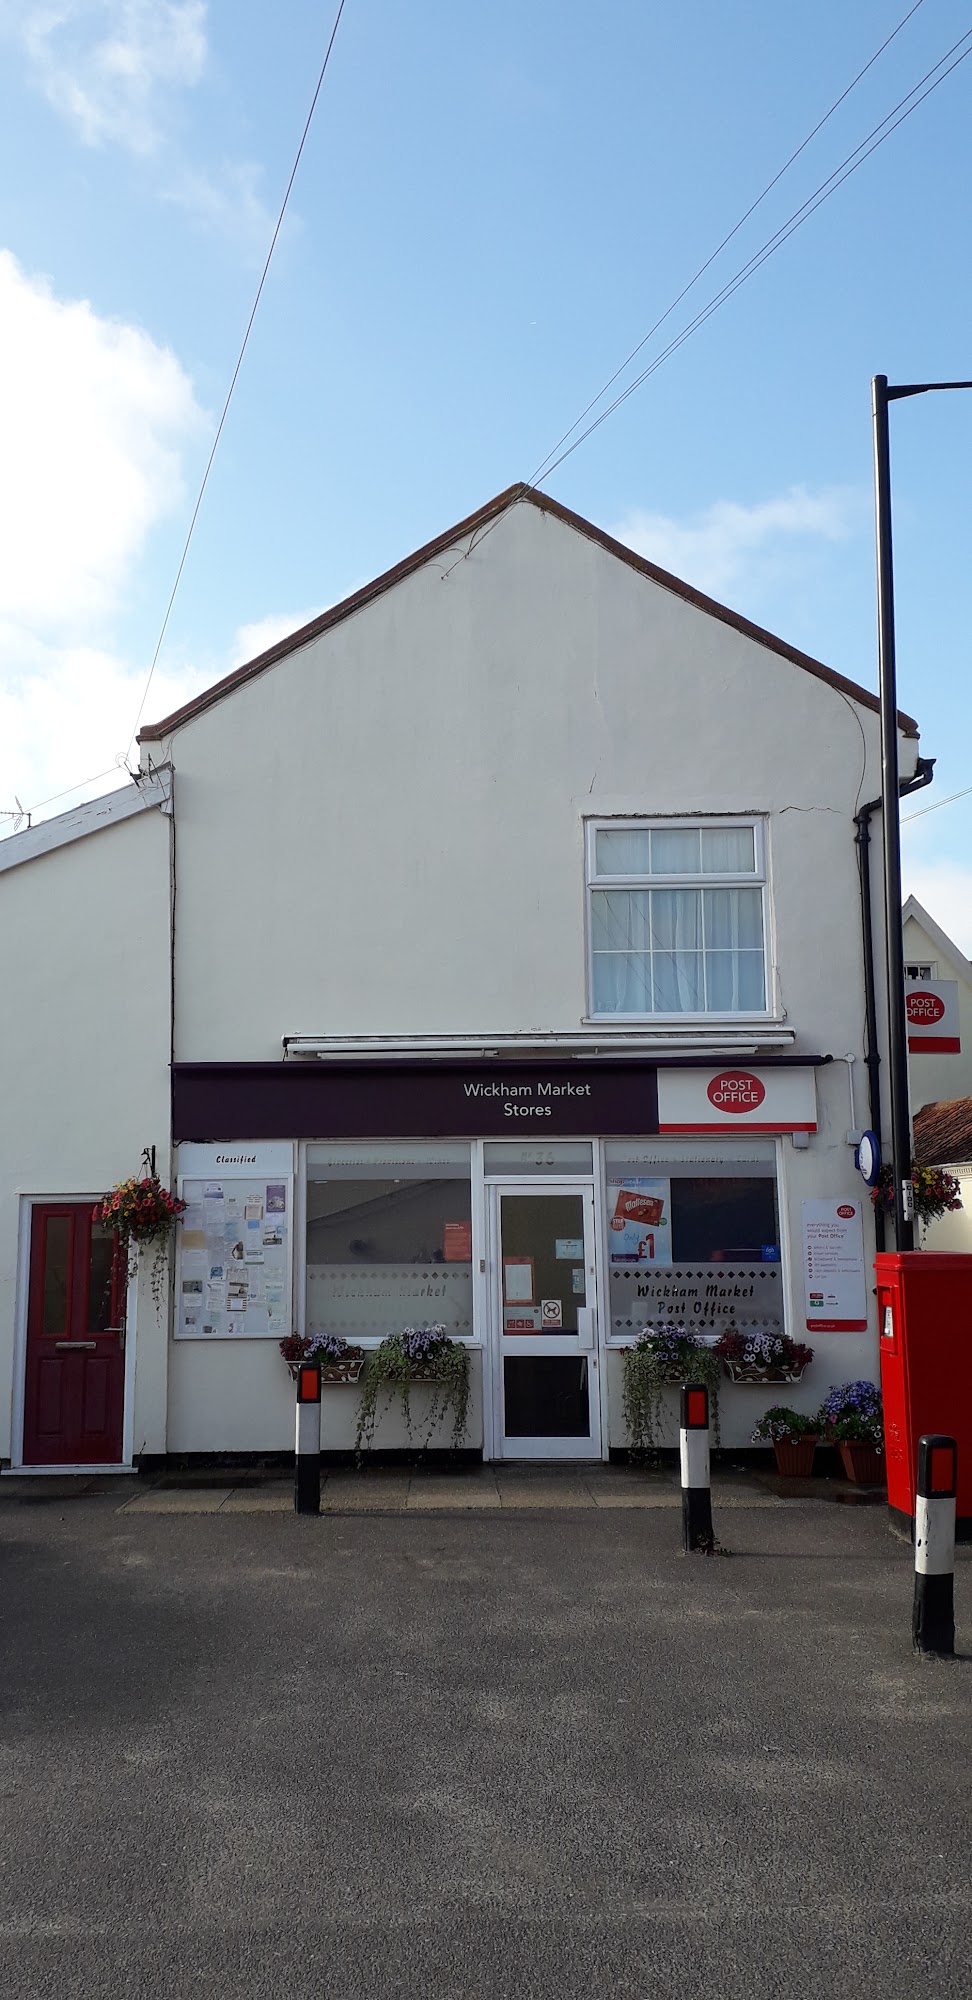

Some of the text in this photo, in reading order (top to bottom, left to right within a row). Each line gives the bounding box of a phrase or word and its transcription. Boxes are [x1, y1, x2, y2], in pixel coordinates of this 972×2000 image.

[910, 998, 936, 1008] POST
[906, 1008, 940, 1017] OFFICE
[463, 1081, 592, 1097] Wickham Market
[720, 1079, 754, 1091] POST
[713, 1091, 759, 1103] OFFICE
[503, 1102, 552, 1117] Stores
[215, 1155, 257, 1165] Classified
[535, 1151, 555, 1166] 36
[637, 1232, 655, 1259] £1
[637, 1284, 755, 1297] Wickham Market
[657, 1301, 736, 1317] Post Office
